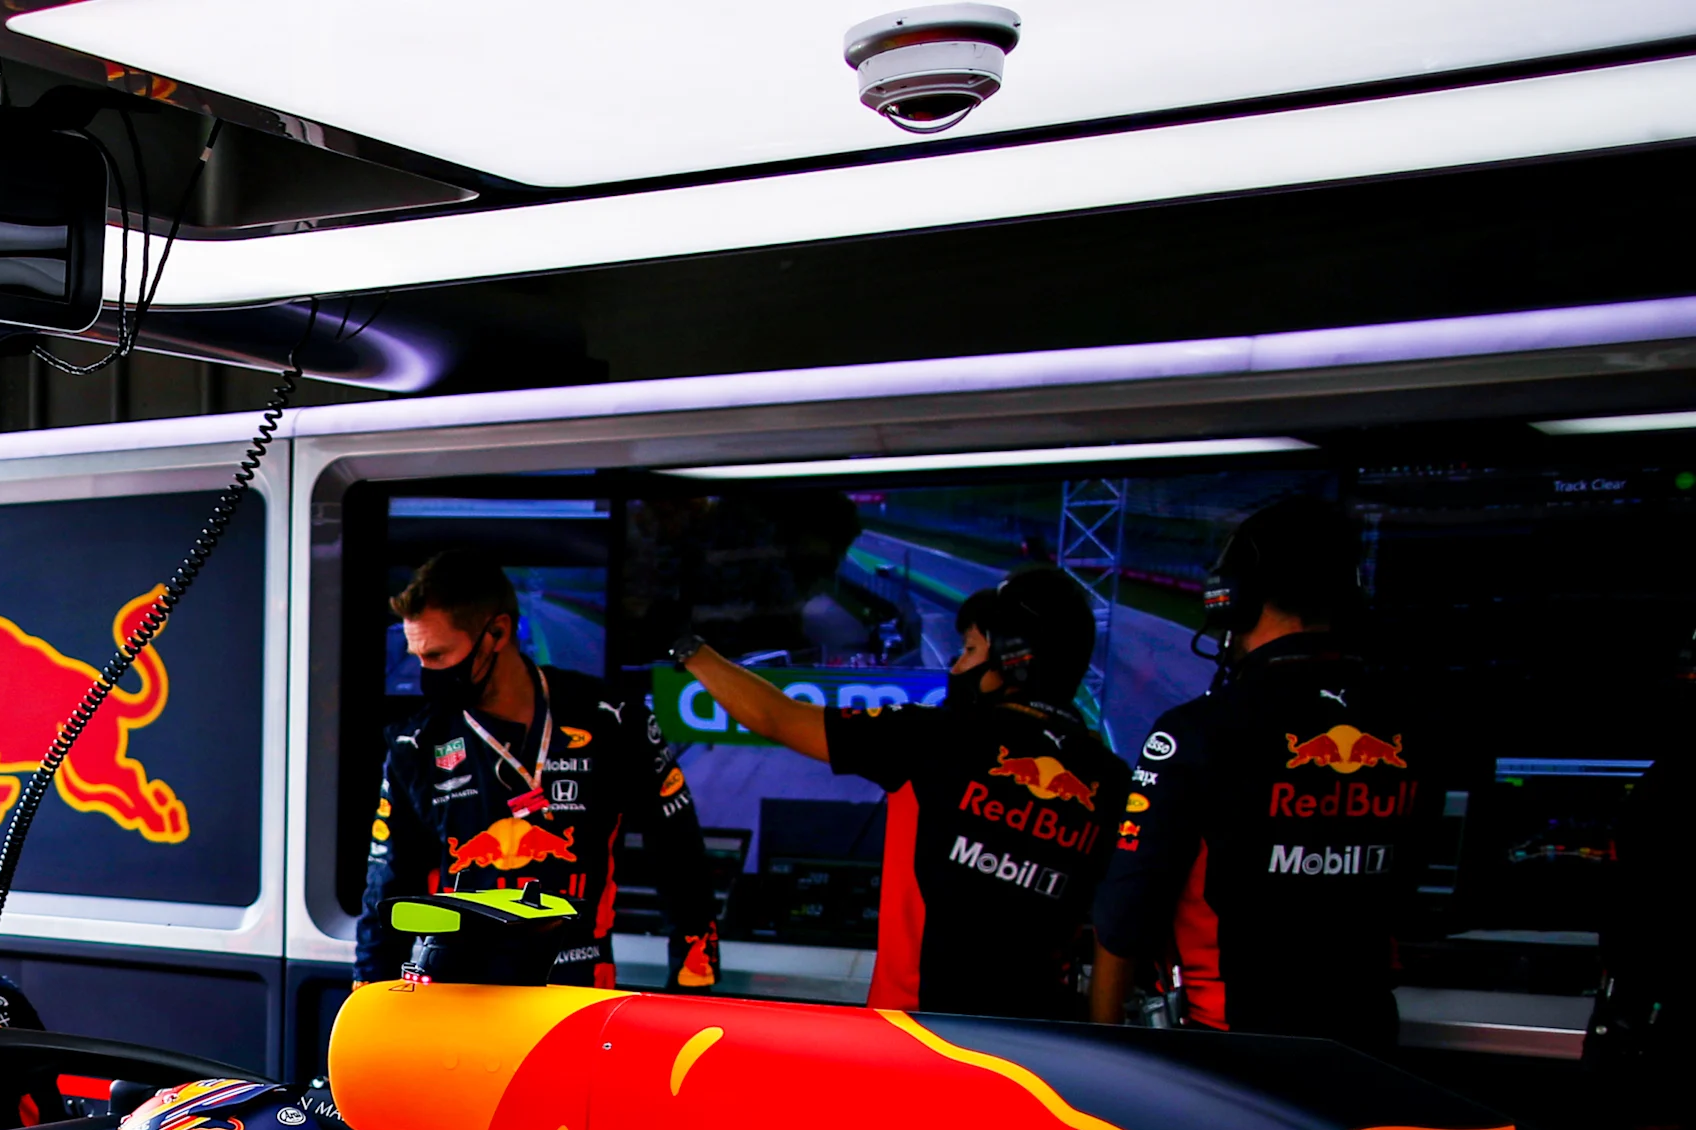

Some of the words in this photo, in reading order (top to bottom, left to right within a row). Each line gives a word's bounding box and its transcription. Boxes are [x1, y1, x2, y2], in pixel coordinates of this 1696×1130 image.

[1553, 479, 1588, 494] Track
[1590, 478, 1628, 492] Clear
[550, 803, 587, 811] ONDA
[948, 835, 1040, 889] Mobil
[1267, 843, 1362, 876] Mobil
[553, 944, 602, 966] LVERSON
